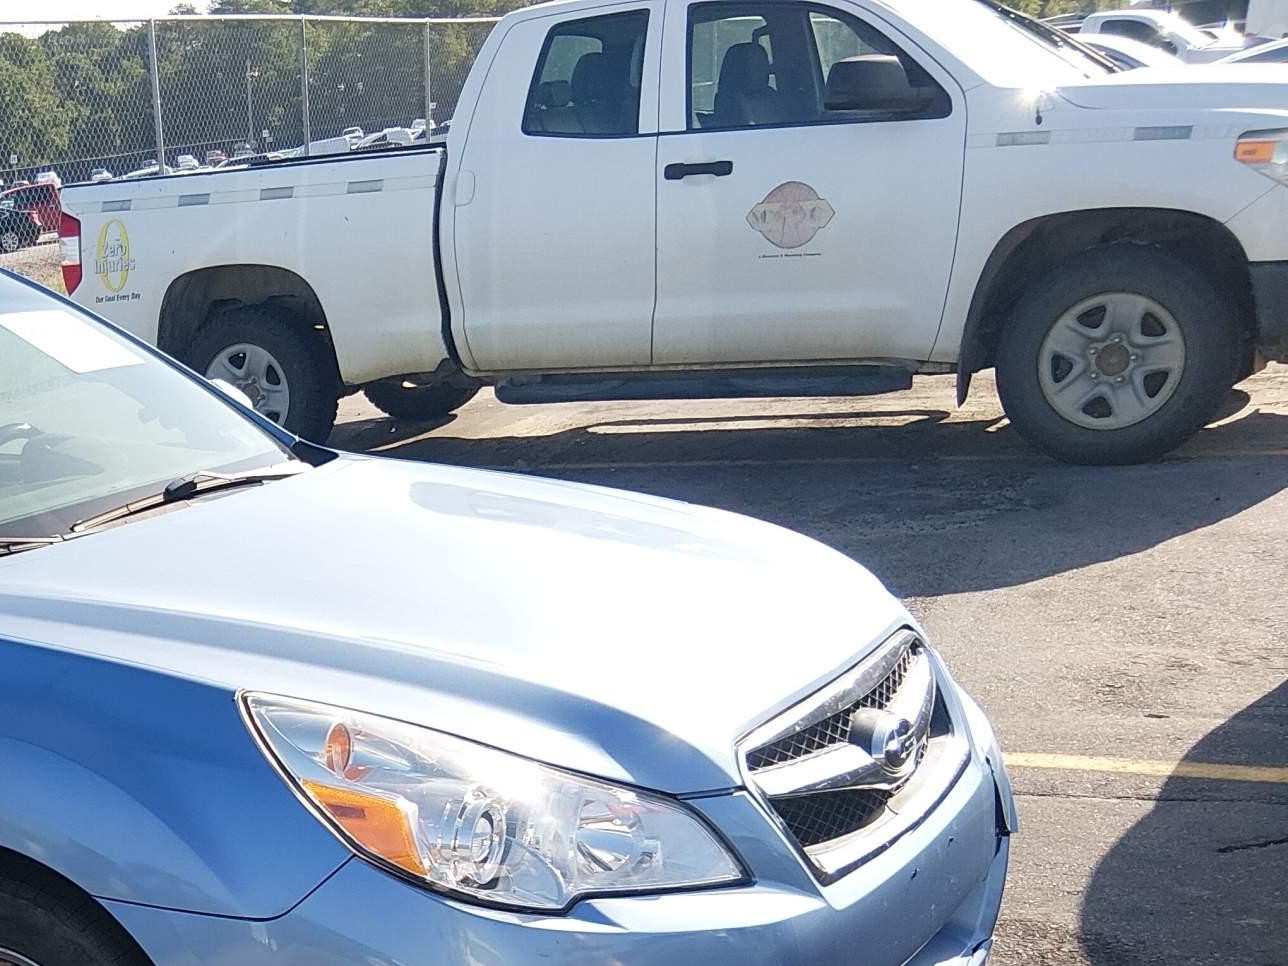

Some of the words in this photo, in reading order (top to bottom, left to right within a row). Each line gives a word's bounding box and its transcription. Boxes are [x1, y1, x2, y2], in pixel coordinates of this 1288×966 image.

[103, 240, 127, 258] Zero
[95, 257, 136, 275] Injuries
[117, 294, 130, 302] Every
[131, 292, 141, 300] Day
